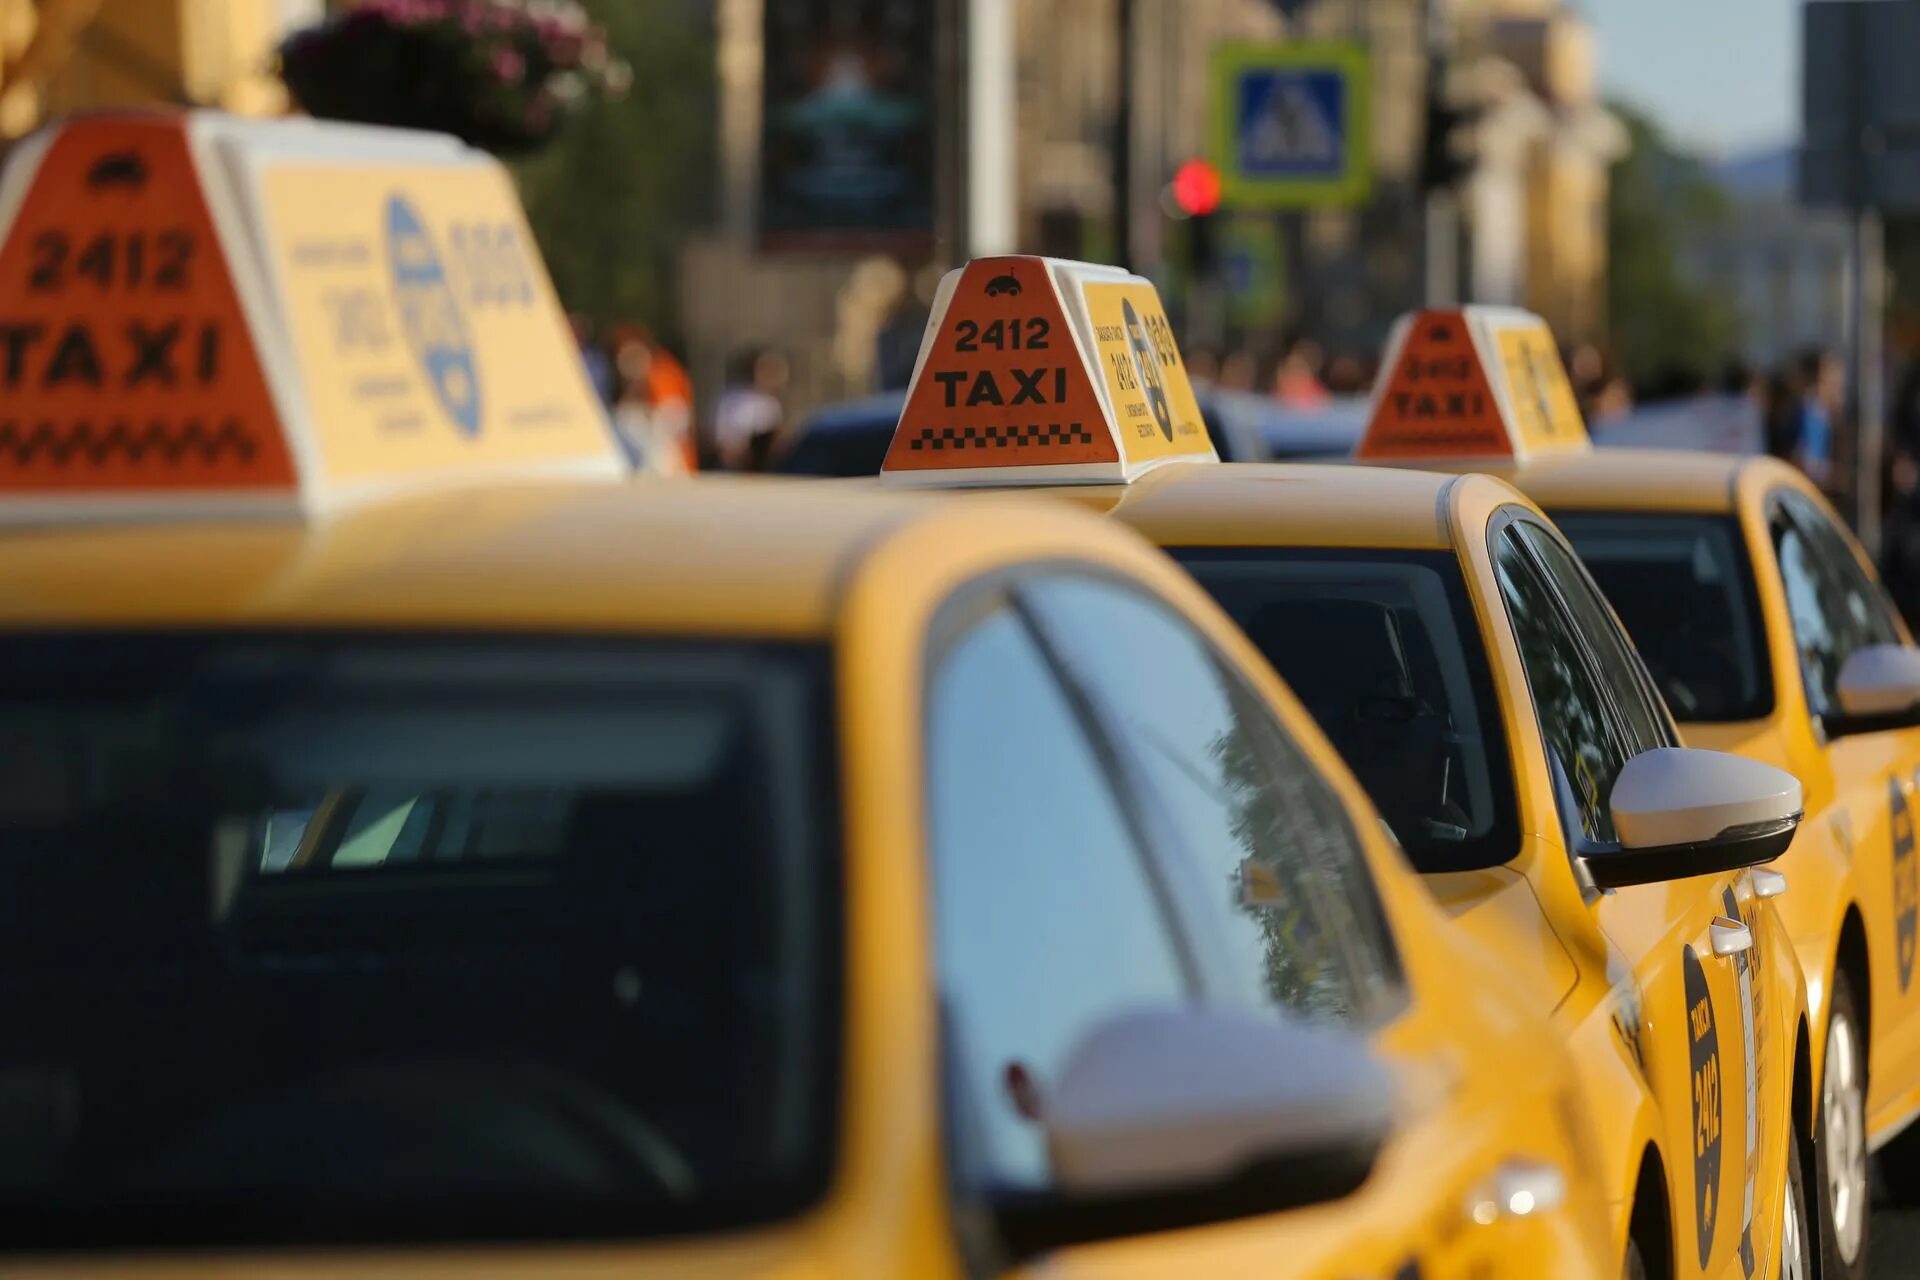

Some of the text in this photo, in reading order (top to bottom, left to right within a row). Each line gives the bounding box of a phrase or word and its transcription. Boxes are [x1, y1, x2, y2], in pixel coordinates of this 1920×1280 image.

[28, 230, 198, 291] 2412
[0, 320, 220, 387] TAXI
[954, 317, 1050, 352] 2412
[934, 367, 1067, 407] TAXI
[1695, 1052, 1720, 1158] 2412
